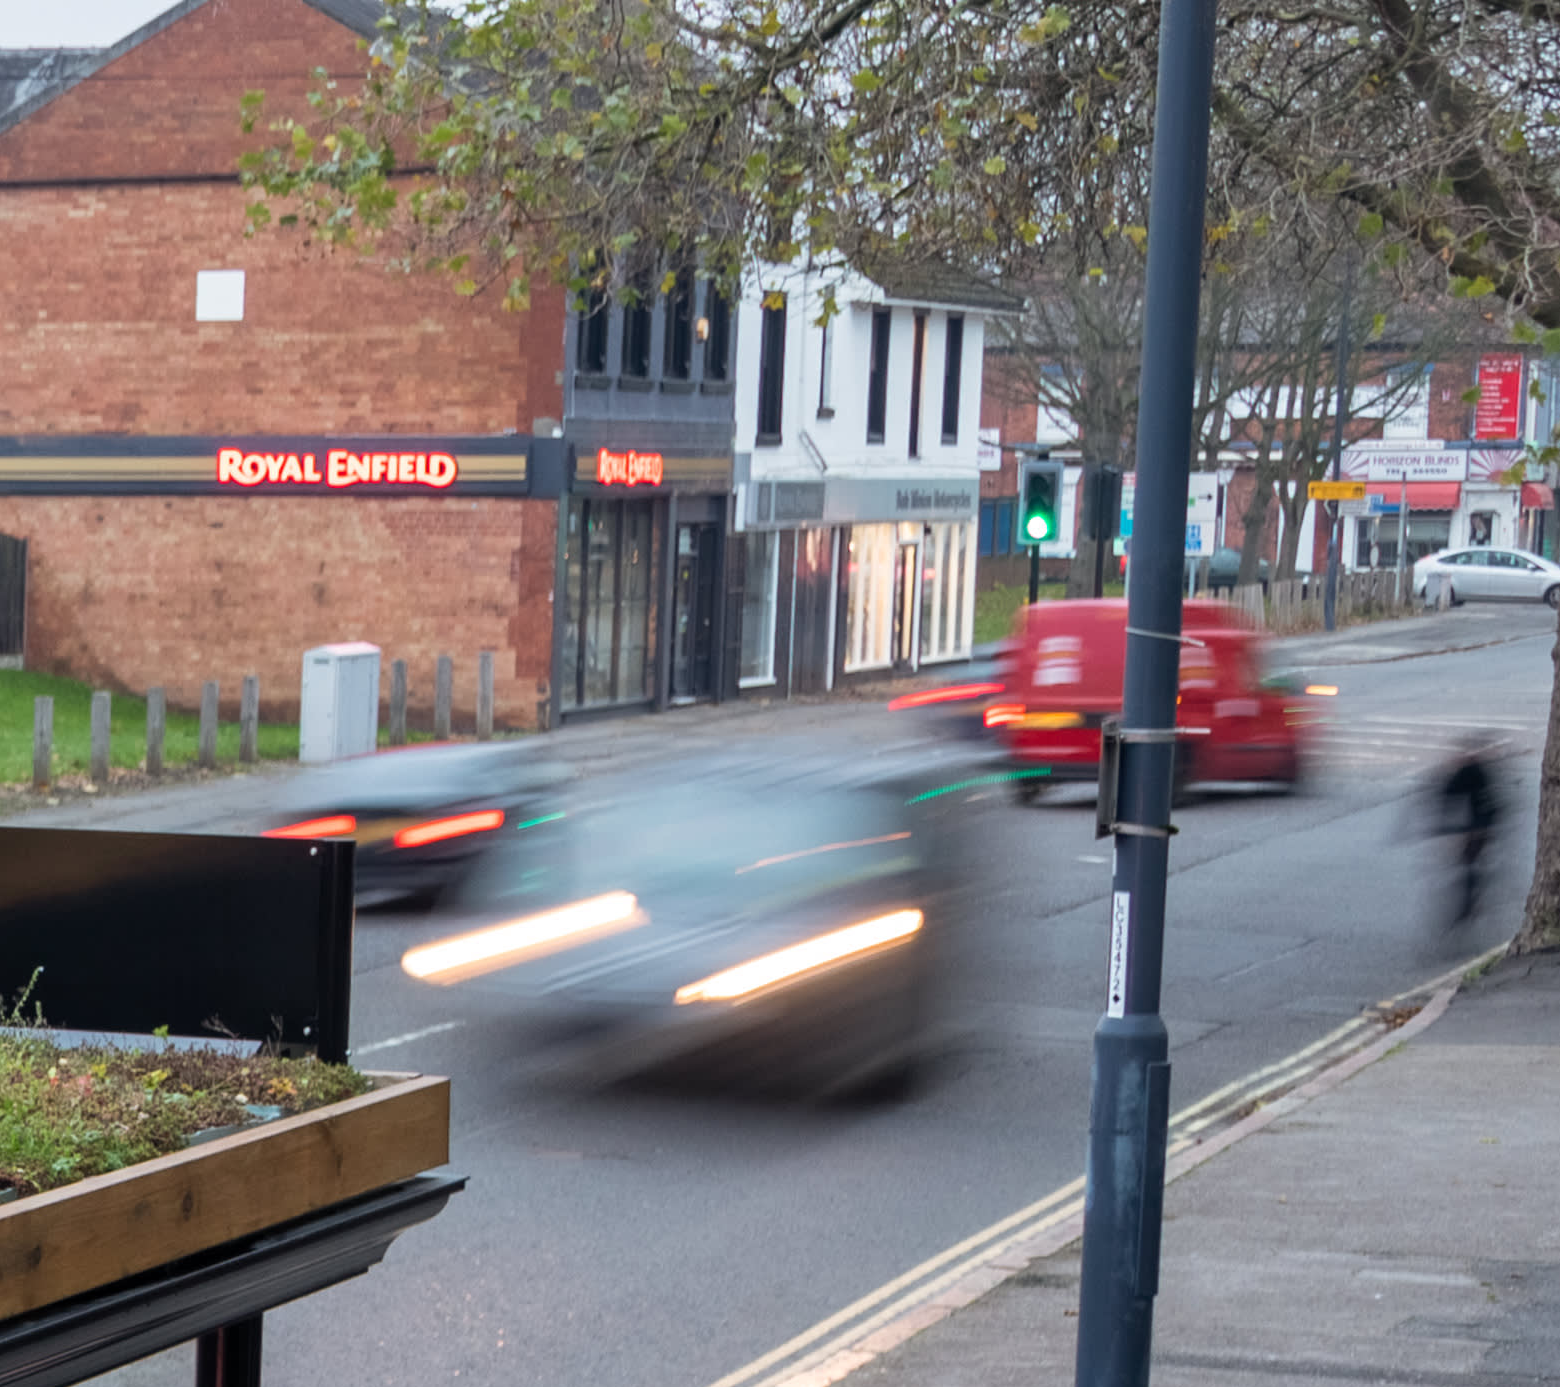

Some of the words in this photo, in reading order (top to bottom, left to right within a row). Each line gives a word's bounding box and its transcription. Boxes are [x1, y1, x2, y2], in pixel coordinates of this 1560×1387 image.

[220, 449, 320, 486] ROYAL
[325, 449, 457, 487] ENFIELD
[597, 448, 627, 486] ROYAL
[627, 450, 663, 486] ENFIELD
